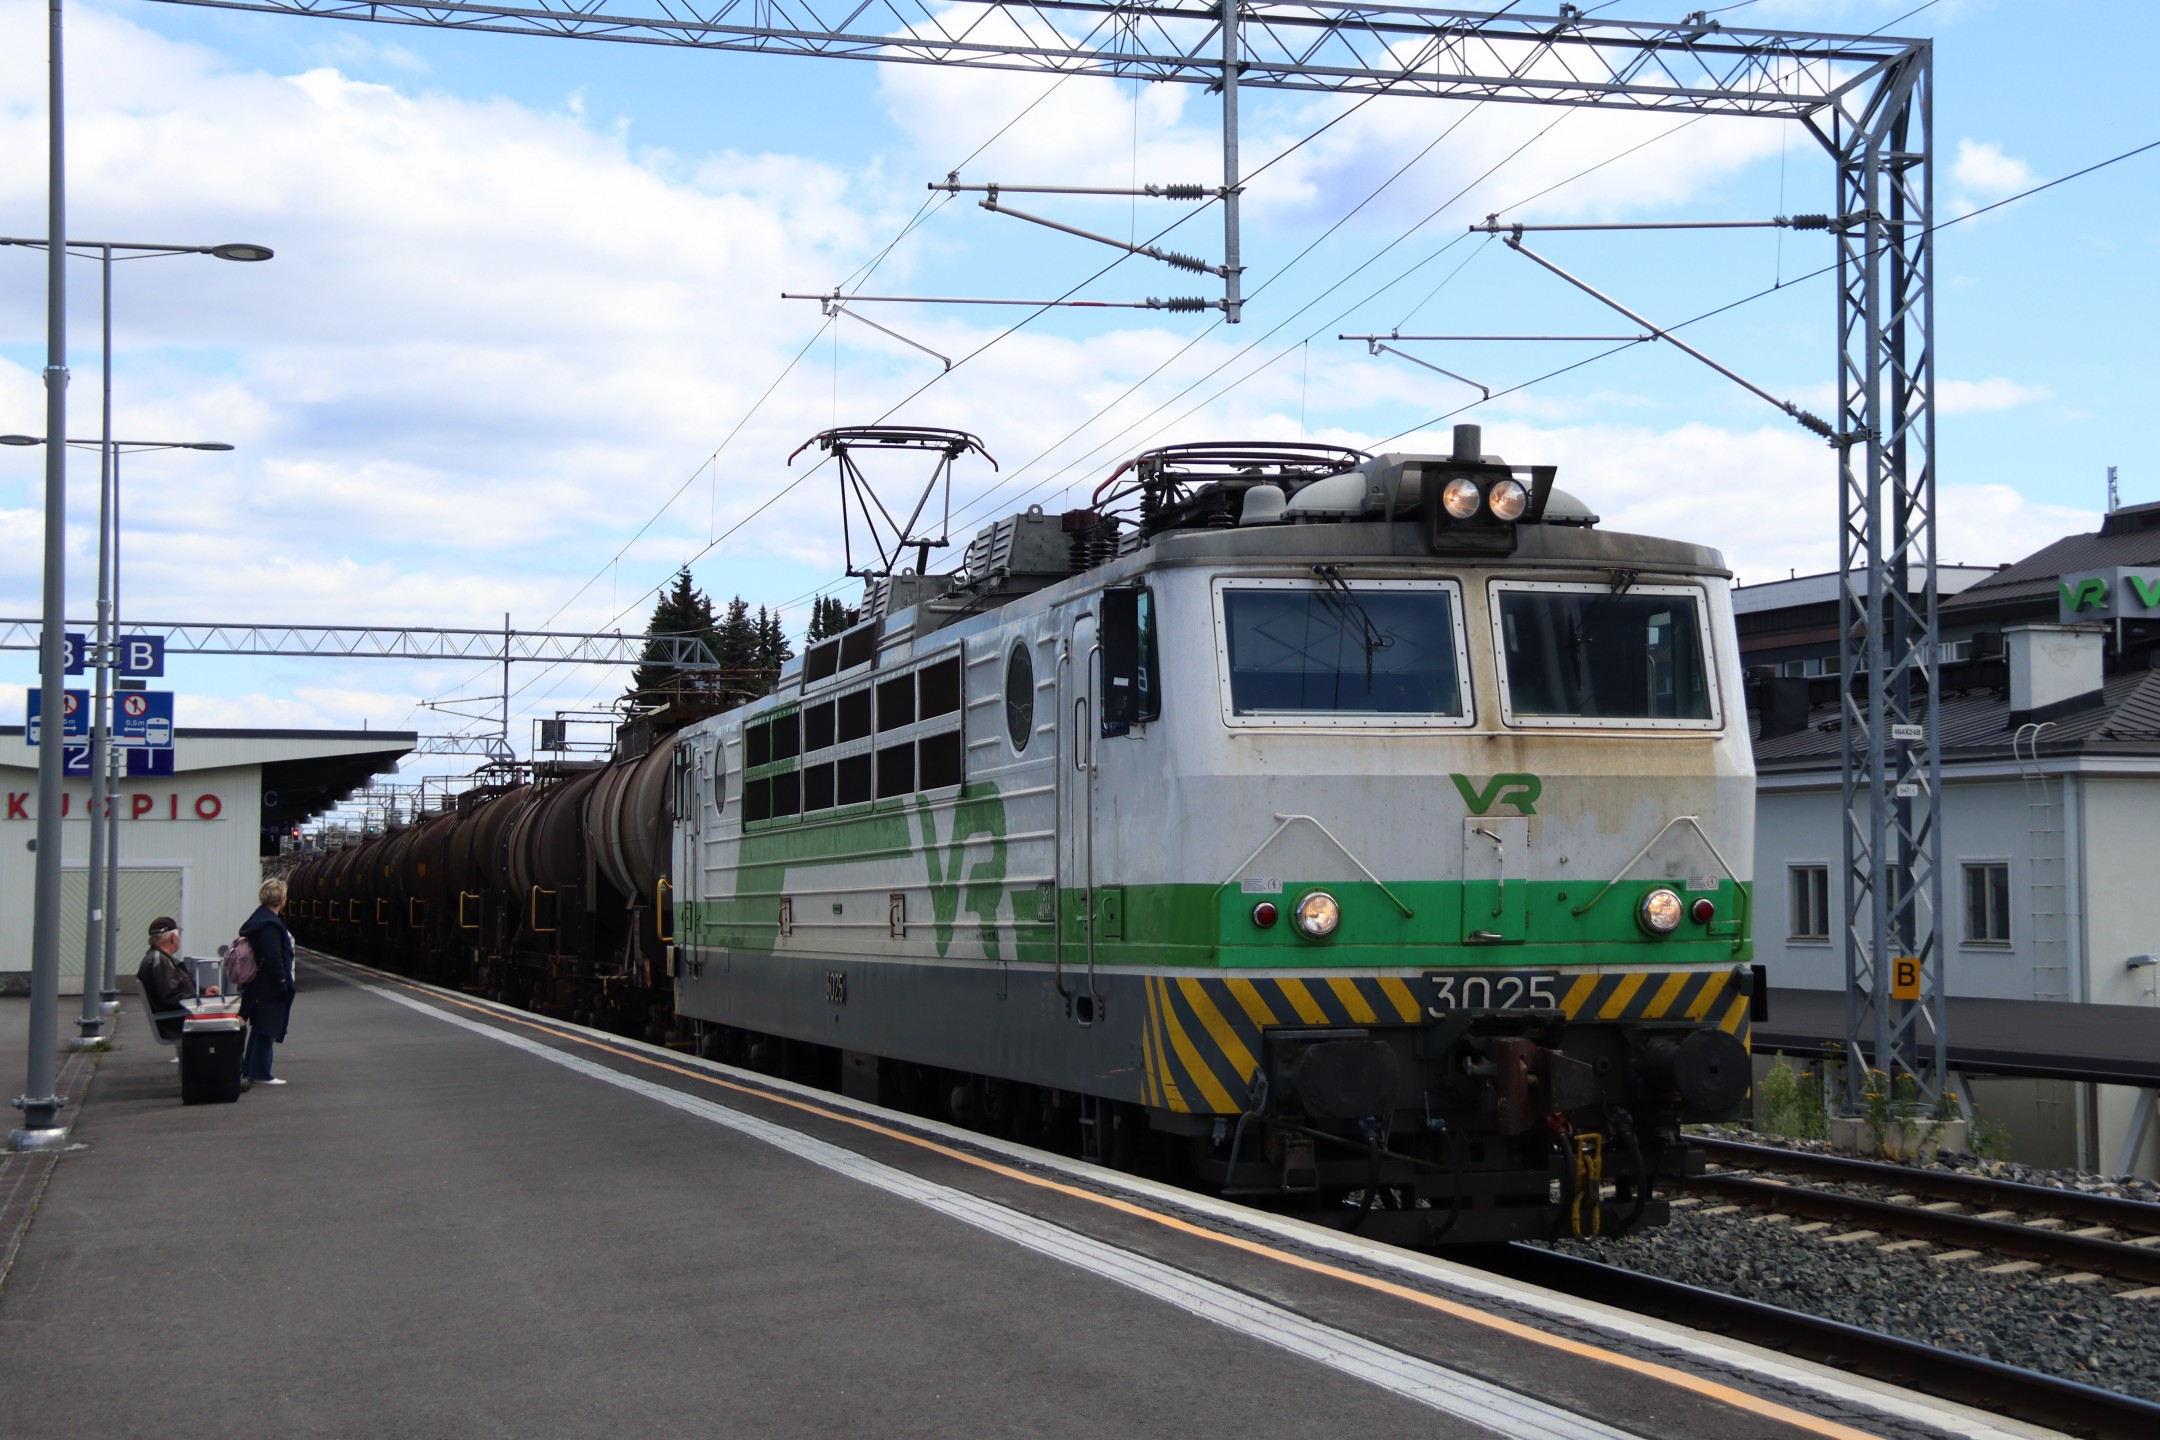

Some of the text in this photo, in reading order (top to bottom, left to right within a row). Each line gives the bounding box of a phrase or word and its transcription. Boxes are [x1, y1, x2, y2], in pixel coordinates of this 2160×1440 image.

[2058, 577, 2107, 612] VR
[130, 642, 154, 670] B
[68, 747, 90, 769] 2
[8, 792, 223, 820] KPIO
[264, 790, 278, 807] C
[1449, 772, 1542, 815] VR
[915, 780, 1008, 961] VR
[1897, 962, 1916, 987] B
[1427, 976, 1556, 1018] 3025
